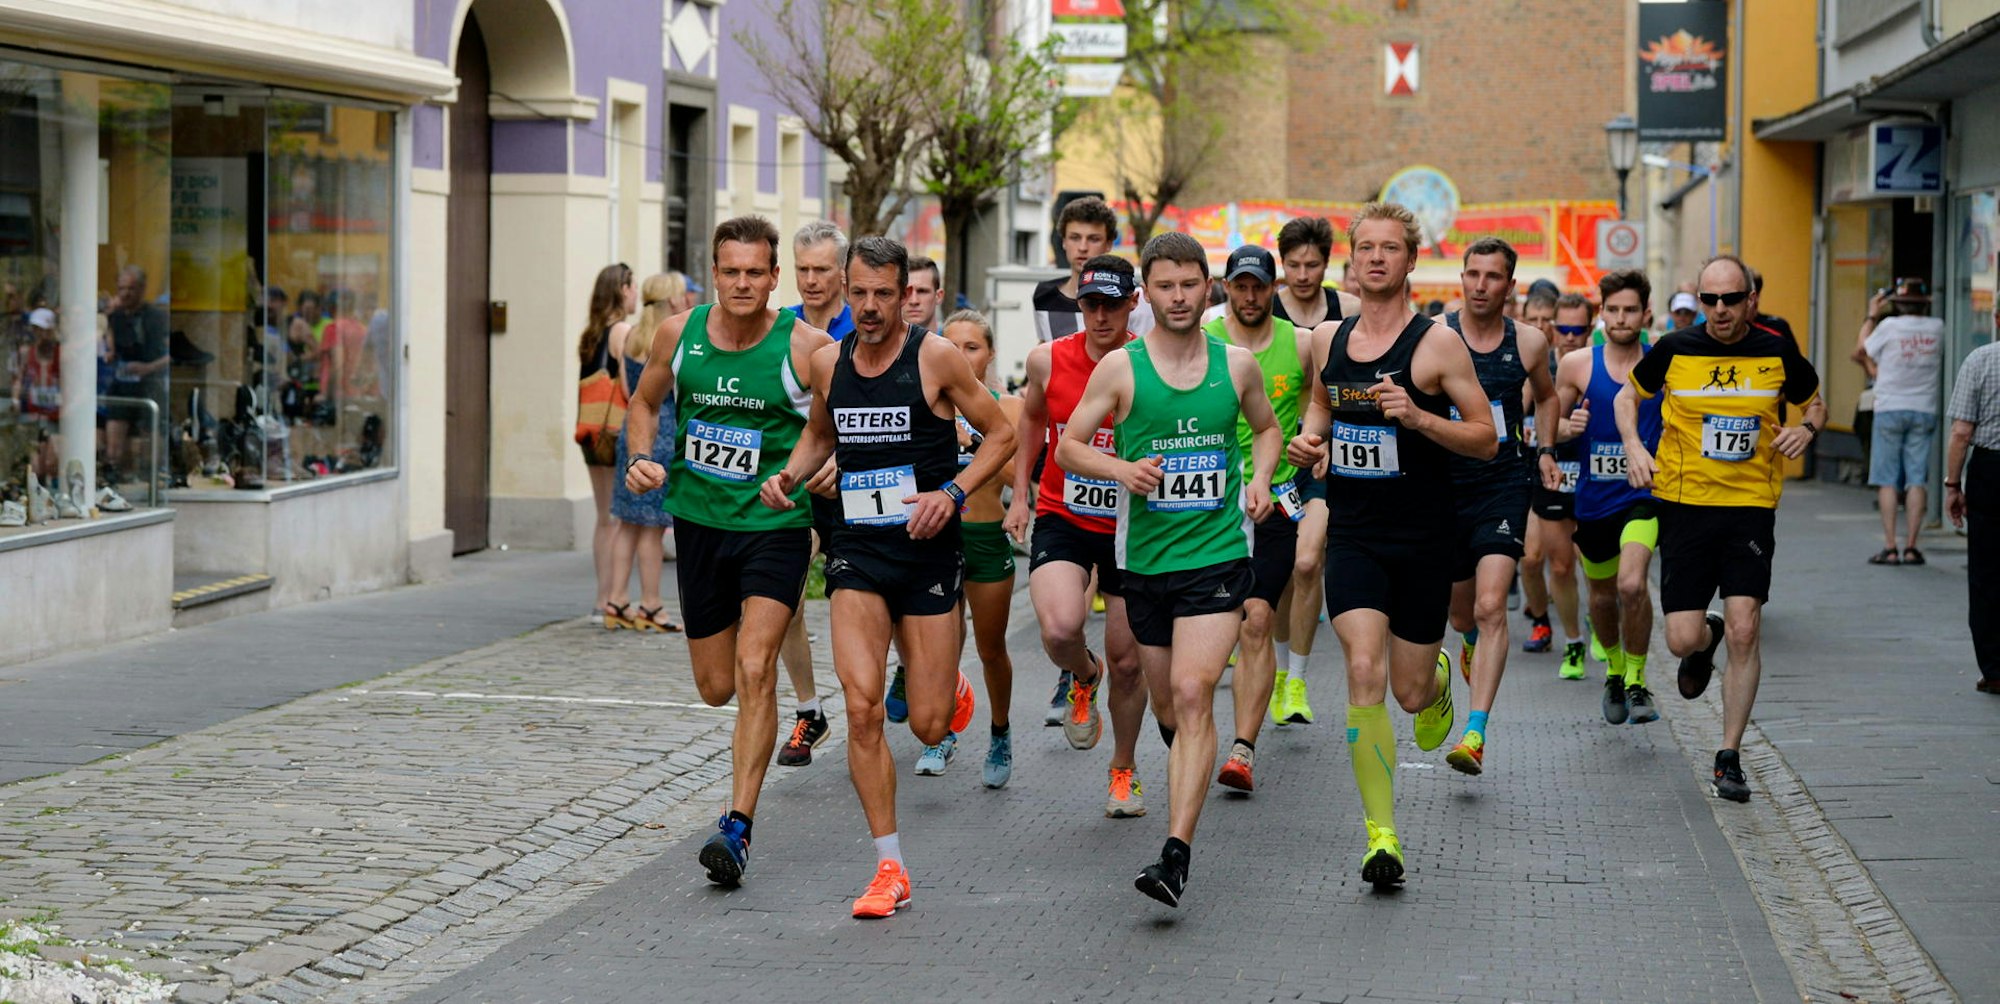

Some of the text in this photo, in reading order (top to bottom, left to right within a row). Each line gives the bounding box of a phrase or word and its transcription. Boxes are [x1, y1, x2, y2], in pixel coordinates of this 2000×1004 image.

[716, 376, 740, 393] LC
[691, 393, 765, 410] EUSKIRCHEN
[838, 411, 907, 429] PETERS
[1177, 417, 1199, 435] LC
[1710, 416, 1755, 430] PETERS
[695, 424, 753, 446] PETERS
[1151, 434, 1225, 451] EUSKIRCHEN
[1714, 431, 1750, 452] 175
[691, 440, 753, 473] 1274
[1158, 454, 1218, 472] PETERS
[1339, 443, 1381, 468] 191
[1157, 472, 1219, 499] 1441
[871, 490, 884, 515] 1
[1073, 484, 1117, 508] 206
